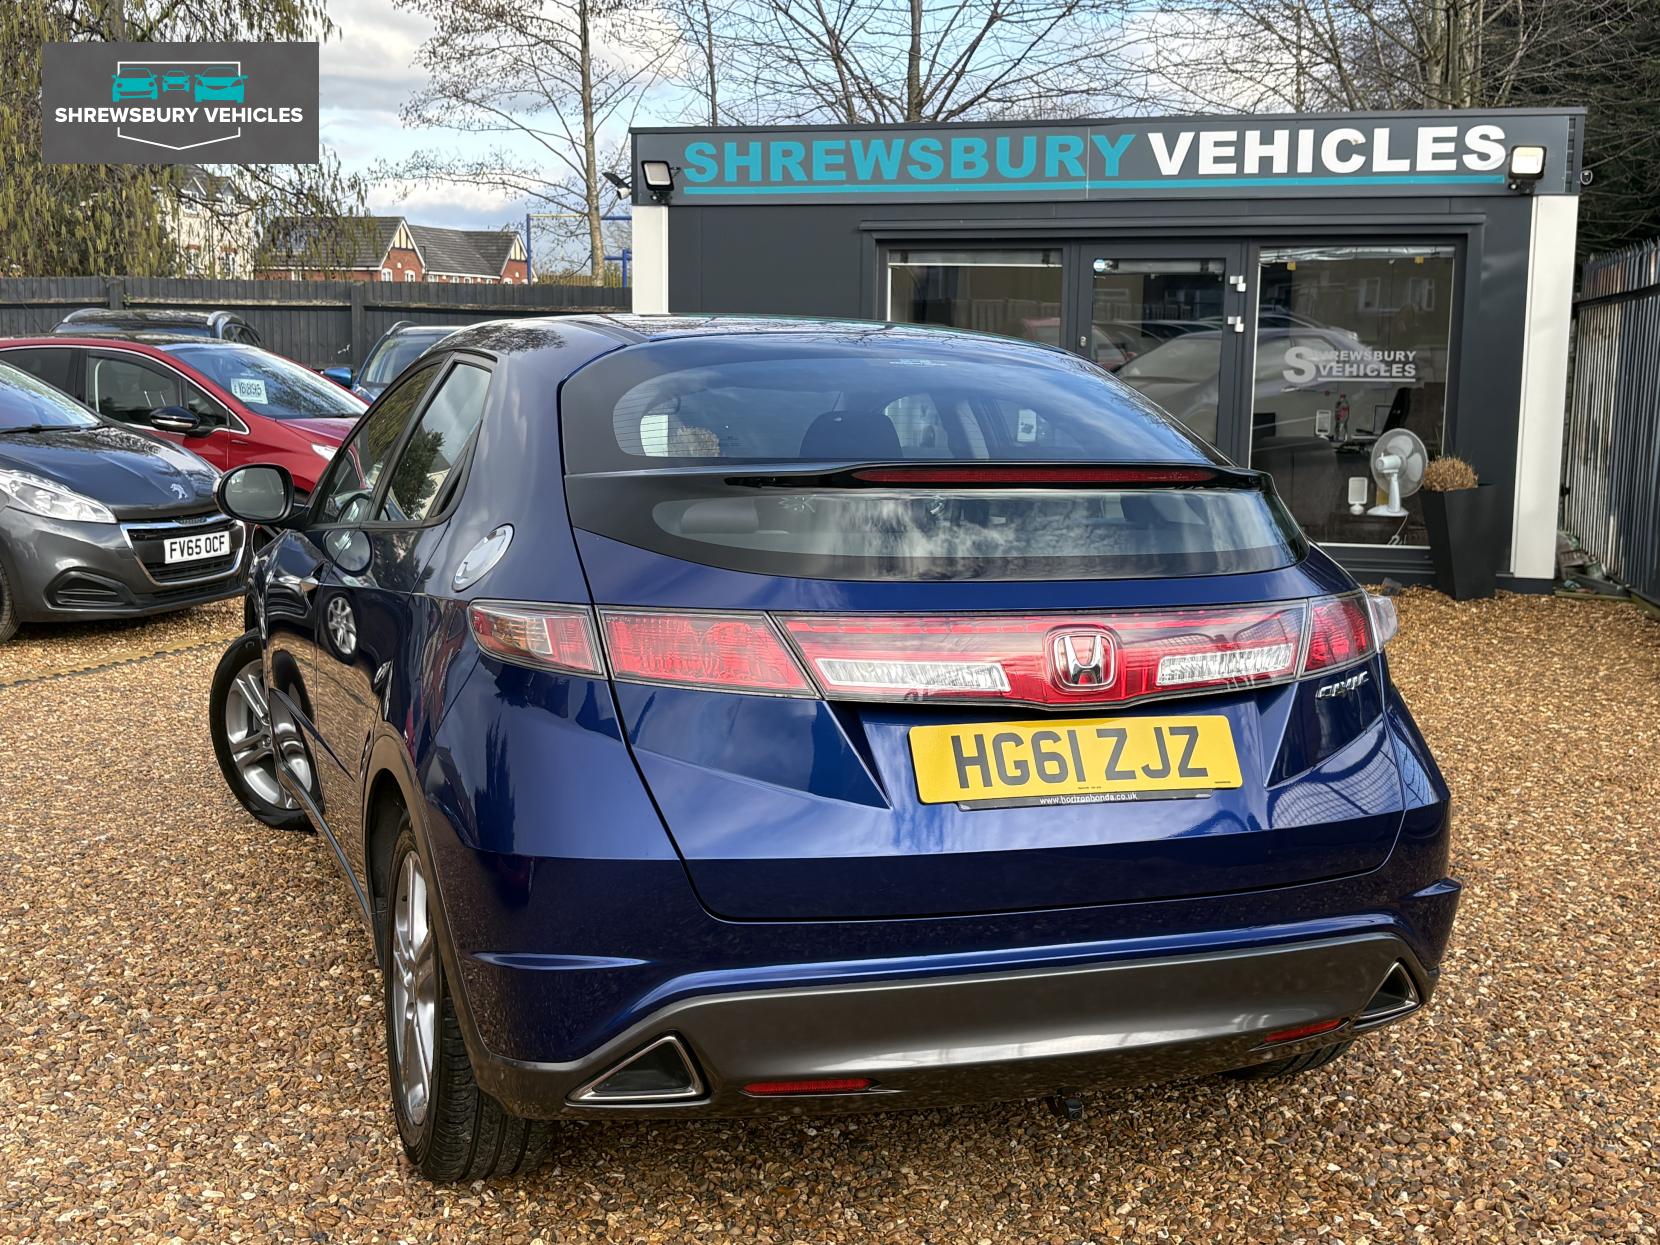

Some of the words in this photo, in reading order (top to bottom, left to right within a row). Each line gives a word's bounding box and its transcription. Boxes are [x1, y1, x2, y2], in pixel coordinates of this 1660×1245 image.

[683, 133, 1136, 183] SHREWSBURY
[1147, 124, 1506, 176] VEHICLES
[1318, 363, 1416, 377] VEHICLES
[169, 538, 202, 559] FV65
[204, 534, 225, 553] OCF
[950, 729, 1087, 789] HG61
[1096, 725, 1209, 781] ZJZ
